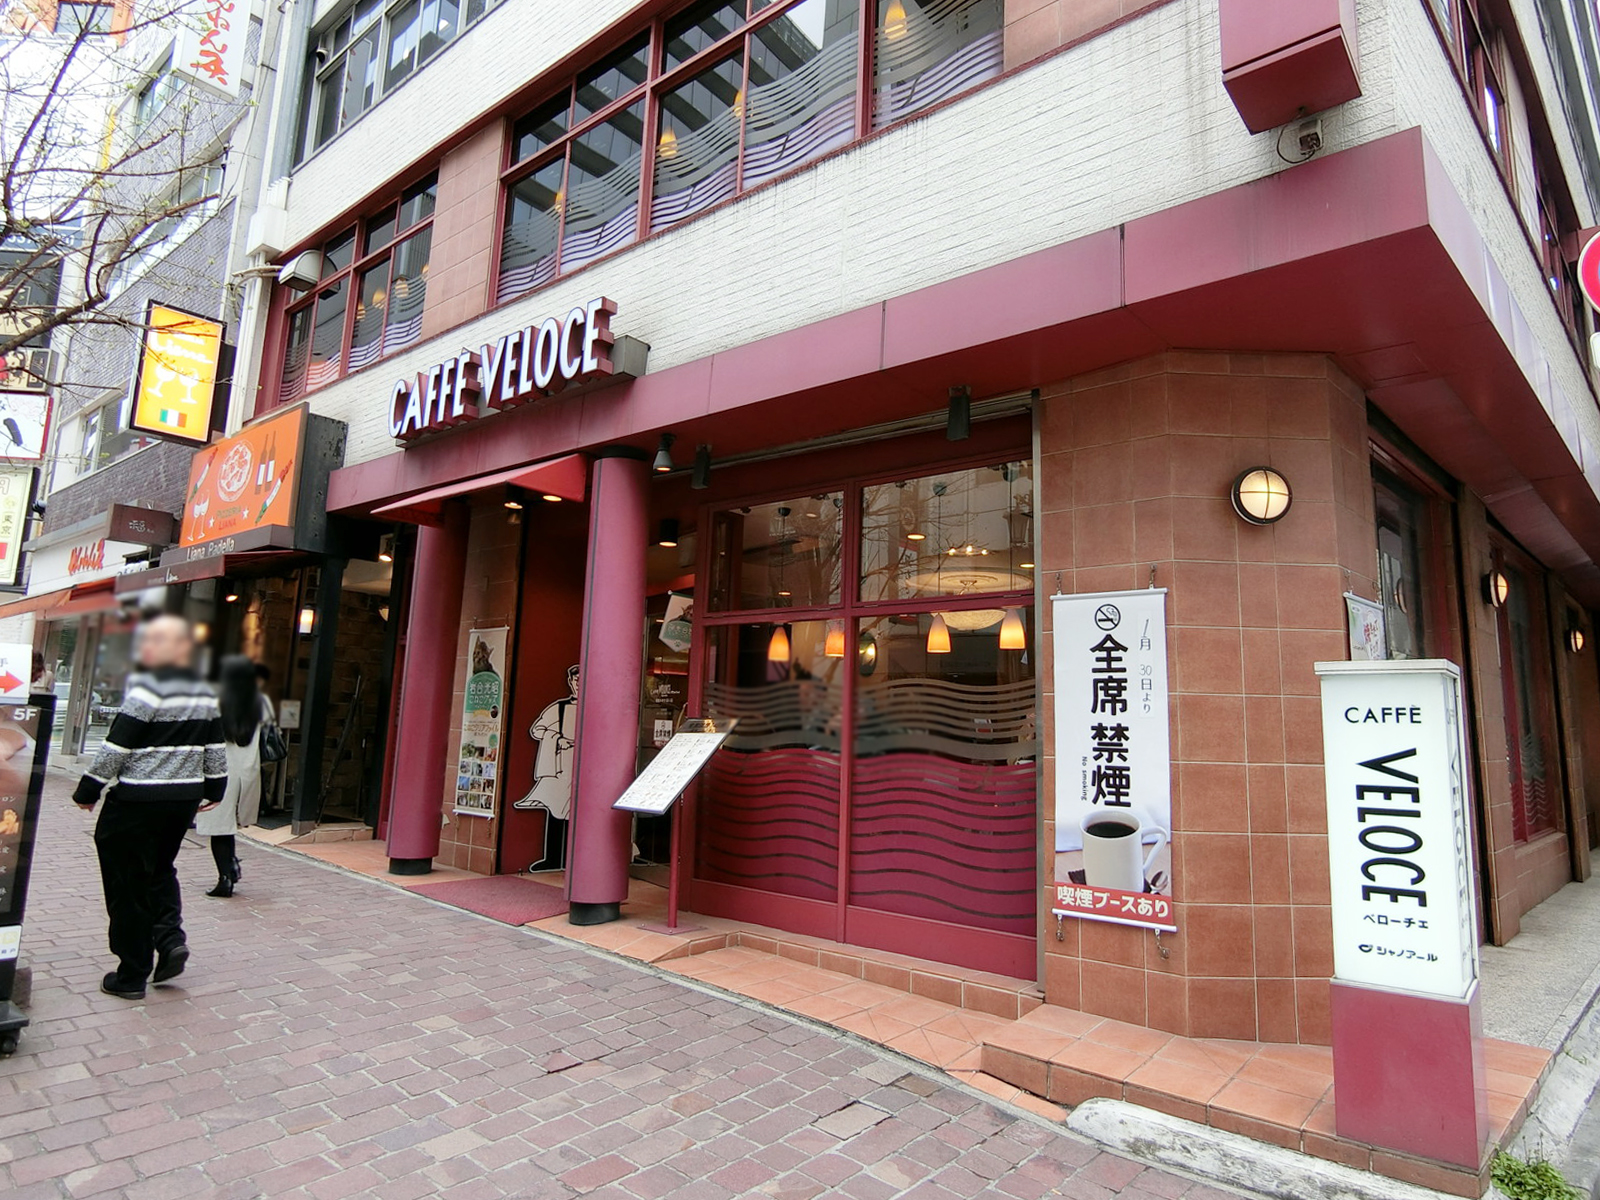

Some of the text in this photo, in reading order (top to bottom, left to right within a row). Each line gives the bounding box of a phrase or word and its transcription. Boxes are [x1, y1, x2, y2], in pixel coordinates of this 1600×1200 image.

[480, 297, 612, 408] VELOCE
[187, 537, 235, 562] Liana Padella
[13, 708, 38, 721] 5F
[1089, 633, 1132, 808] 全席禁煙
[1344, 705, 1422, 724] CAFFÈ
[1080, 756, 1088, 801] No smoking
[1355, 747, 1428, 908] VELOCE
[1057, 886, 1169, 918] 喫煙ブースあり
[1363, 914, 1429, 929] ベローチェ
[1376, 945, 1438, 962] シャノアール
